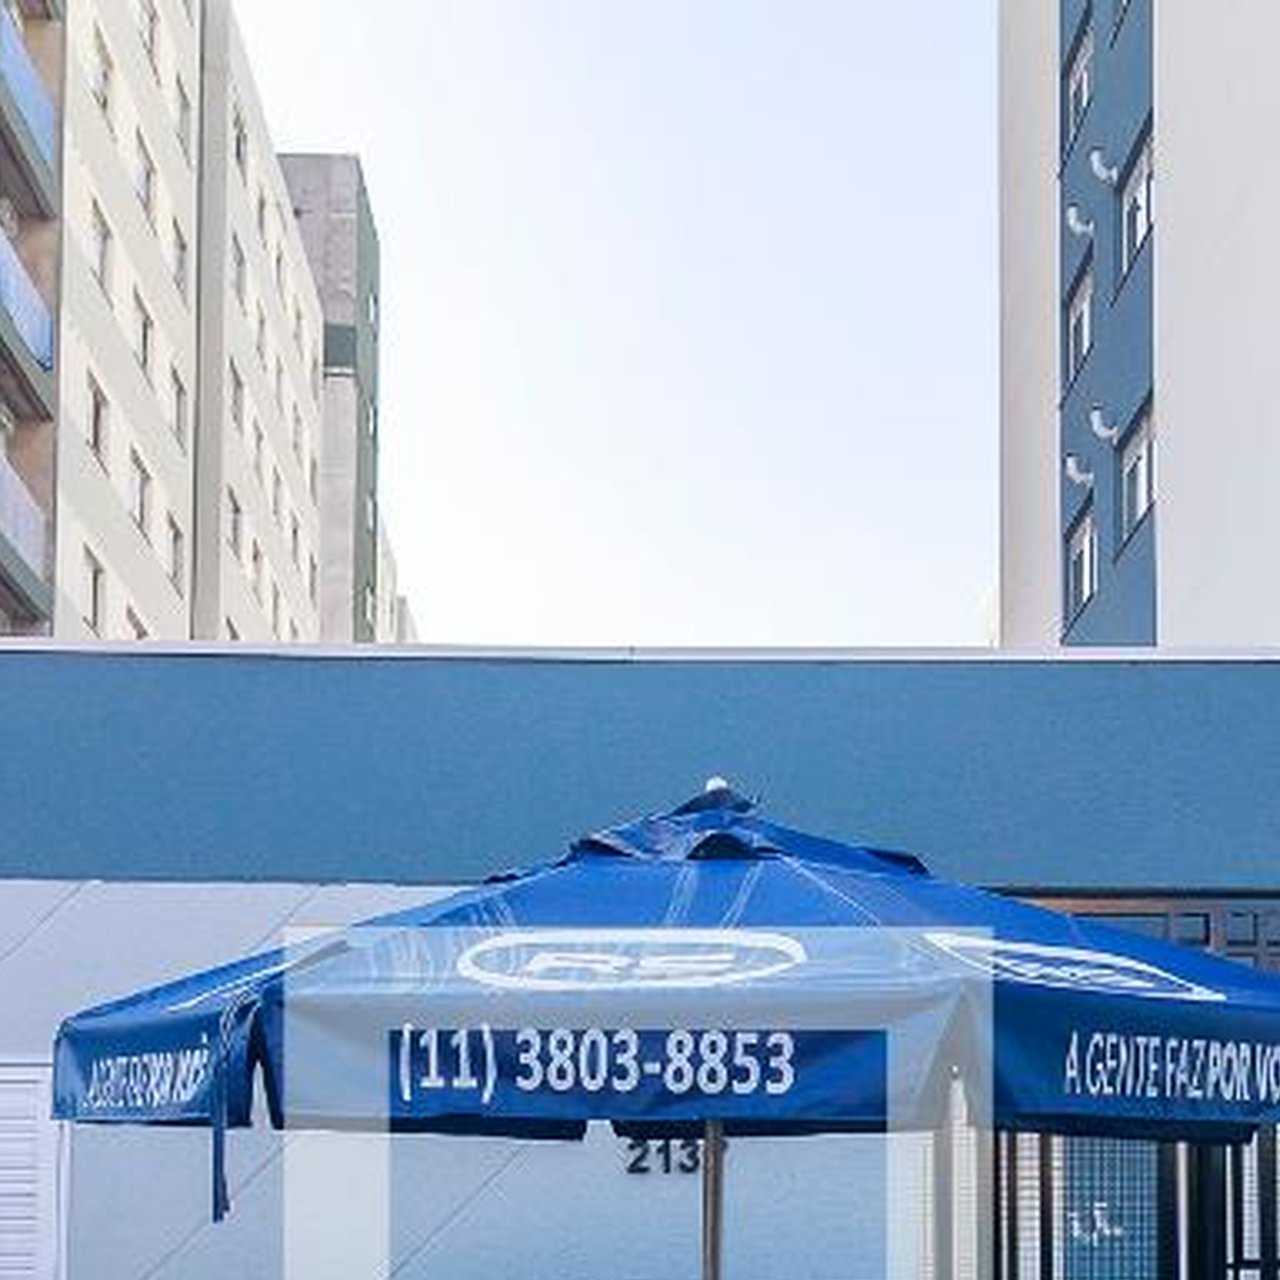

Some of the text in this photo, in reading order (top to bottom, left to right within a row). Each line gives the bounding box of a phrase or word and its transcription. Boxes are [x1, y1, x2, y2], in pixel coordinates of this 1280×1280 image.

[400, 1022, 796, 1104] (11) 3803-8853
[1064, 1029, 1082, 1095] A
[1085, 1032, 1162, 1098] GENTE
[1165, 1037, 1209, 1099] FAZ
[1206, 1041, 1251, 1101] POR
[626, 1138, 728, 1174] 213
